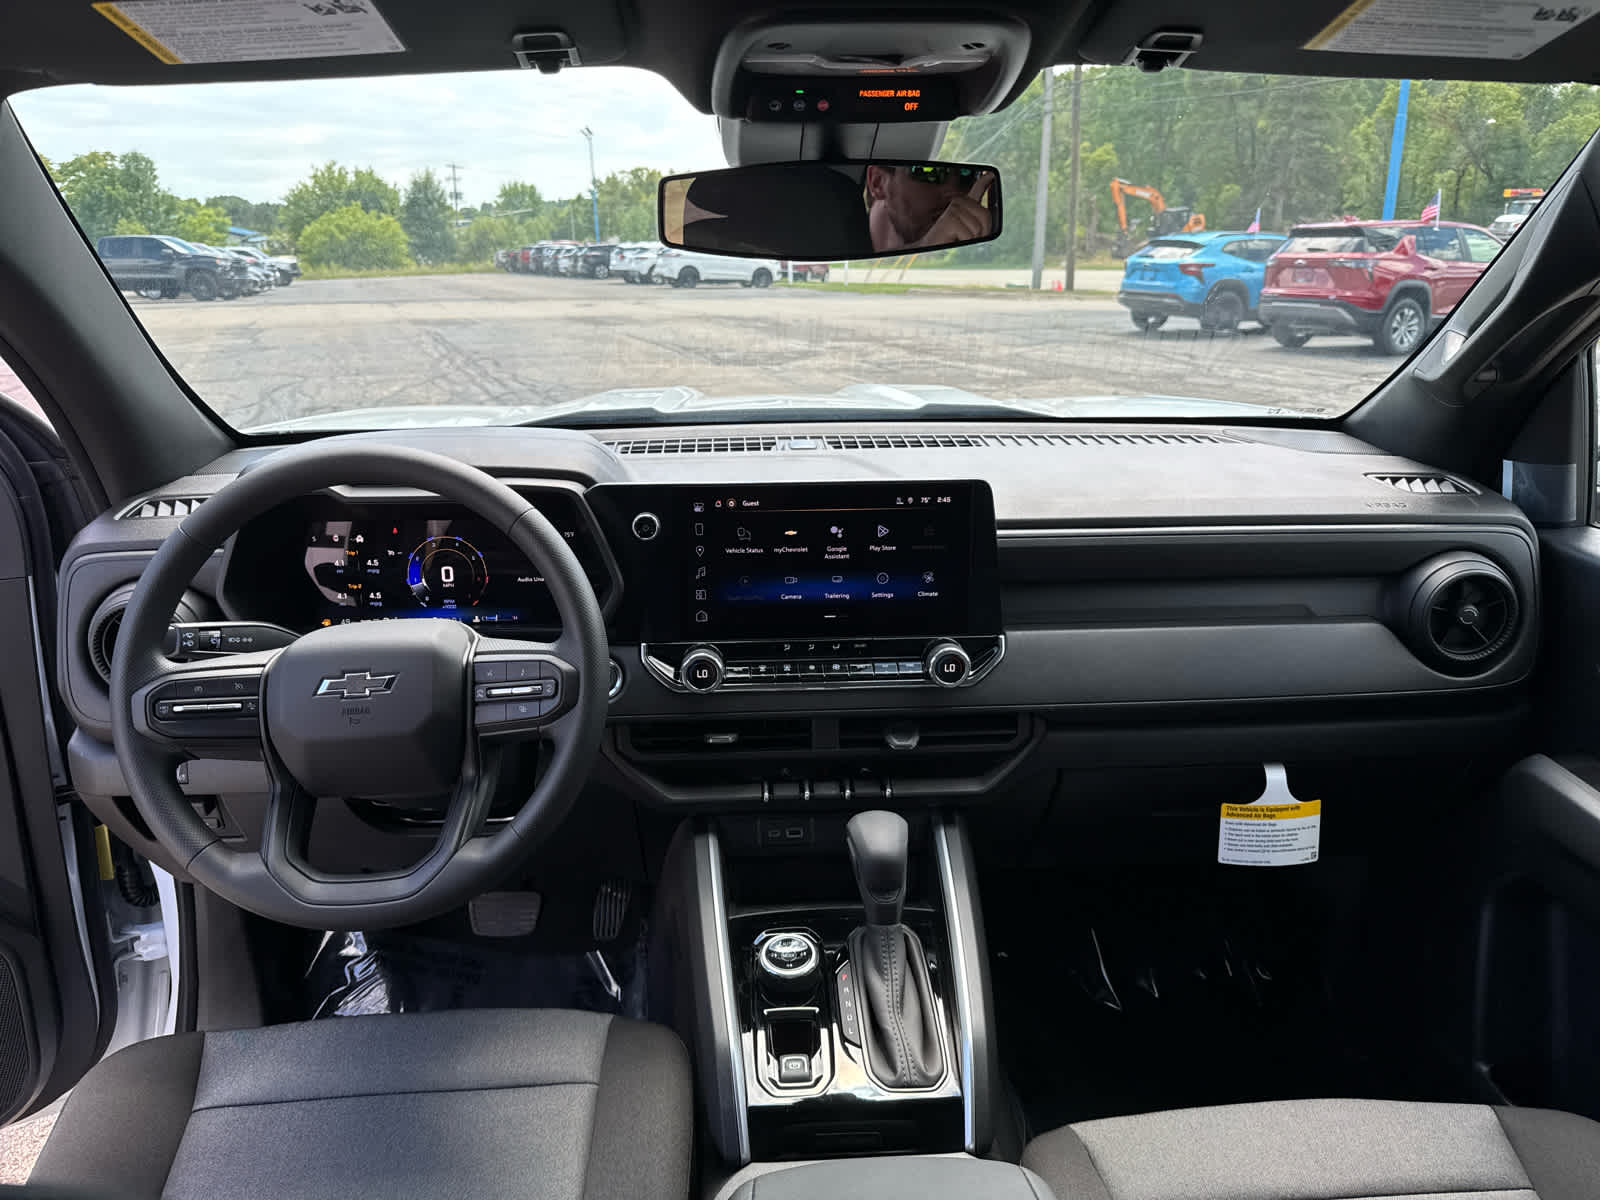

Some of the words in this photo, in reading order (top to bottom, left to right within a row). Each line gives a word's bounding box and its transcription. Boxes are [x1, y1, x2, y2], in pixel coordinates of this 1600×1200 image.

[859, 89, 895, 97] PASSENGER
[904, 102, 919, 111] OFF
[773, 546, 808, 555] myChevrolet
[441, 566, 454, 582] 0
[824, 592, 850, 600] Trailering
[944, 663, 956, 673] LO
[696, 669, 708, 679] LO
